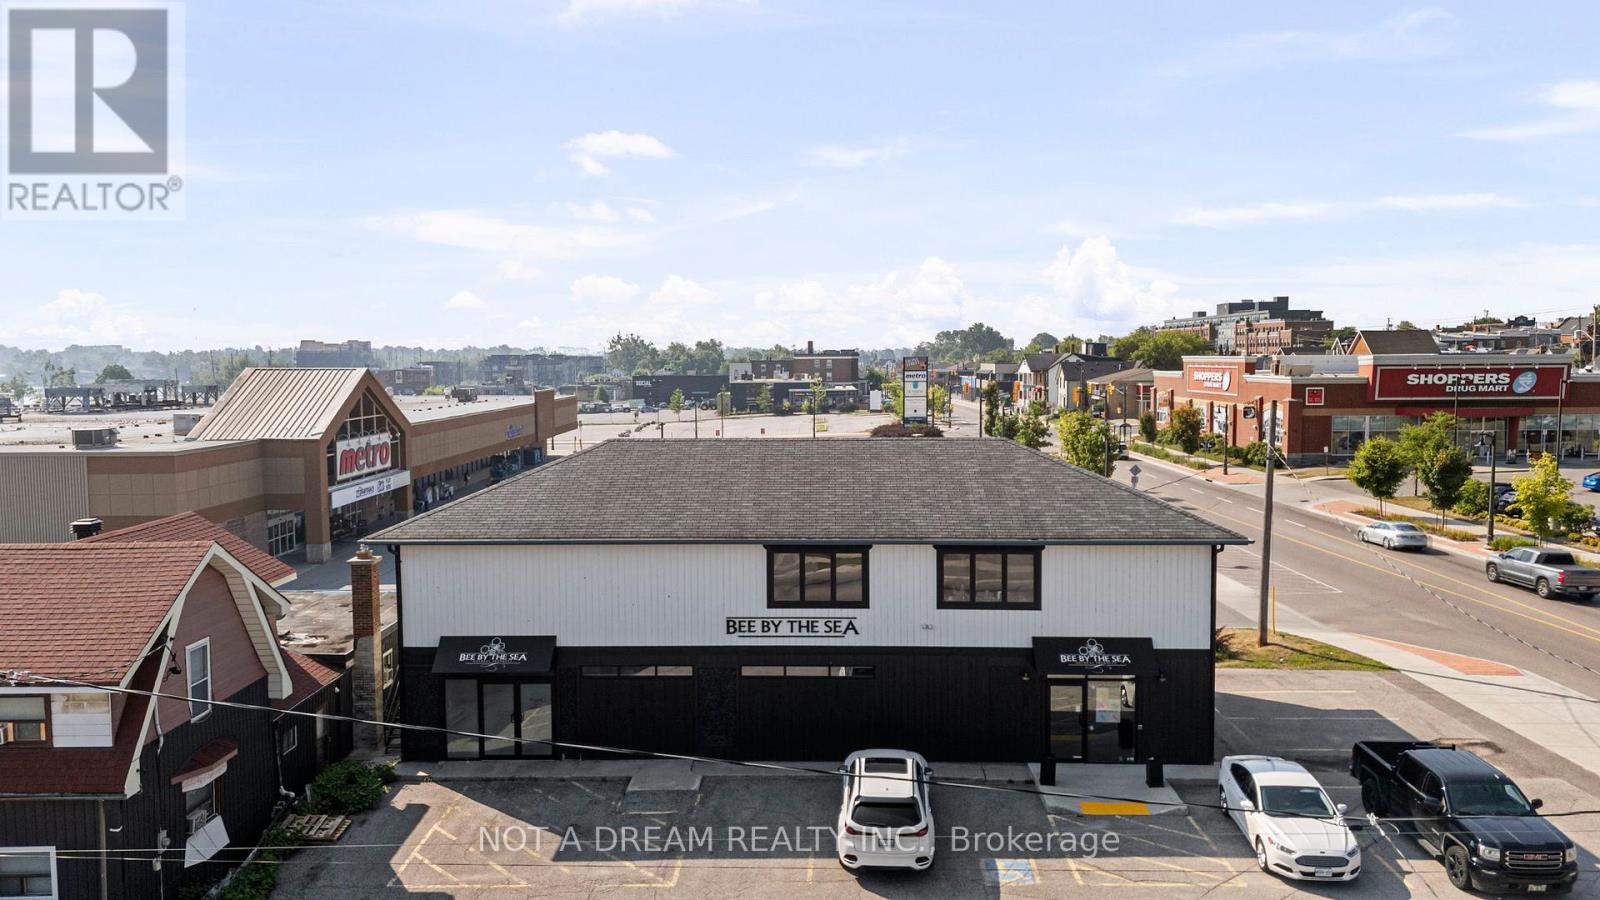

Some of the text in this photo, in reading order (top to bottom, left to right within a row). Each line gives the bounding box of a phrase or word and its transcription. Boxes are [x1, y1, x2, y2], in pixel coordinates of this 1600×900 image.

[339, 441, 391, 476] metro
[726, 619, 860, 635] BEE BY THE SEA
[459, 653, 527, 662] BEE BY THE SEA
[1060, 654, 1077, 663] BEE
[1112, 655, 1131, 663] SEA
